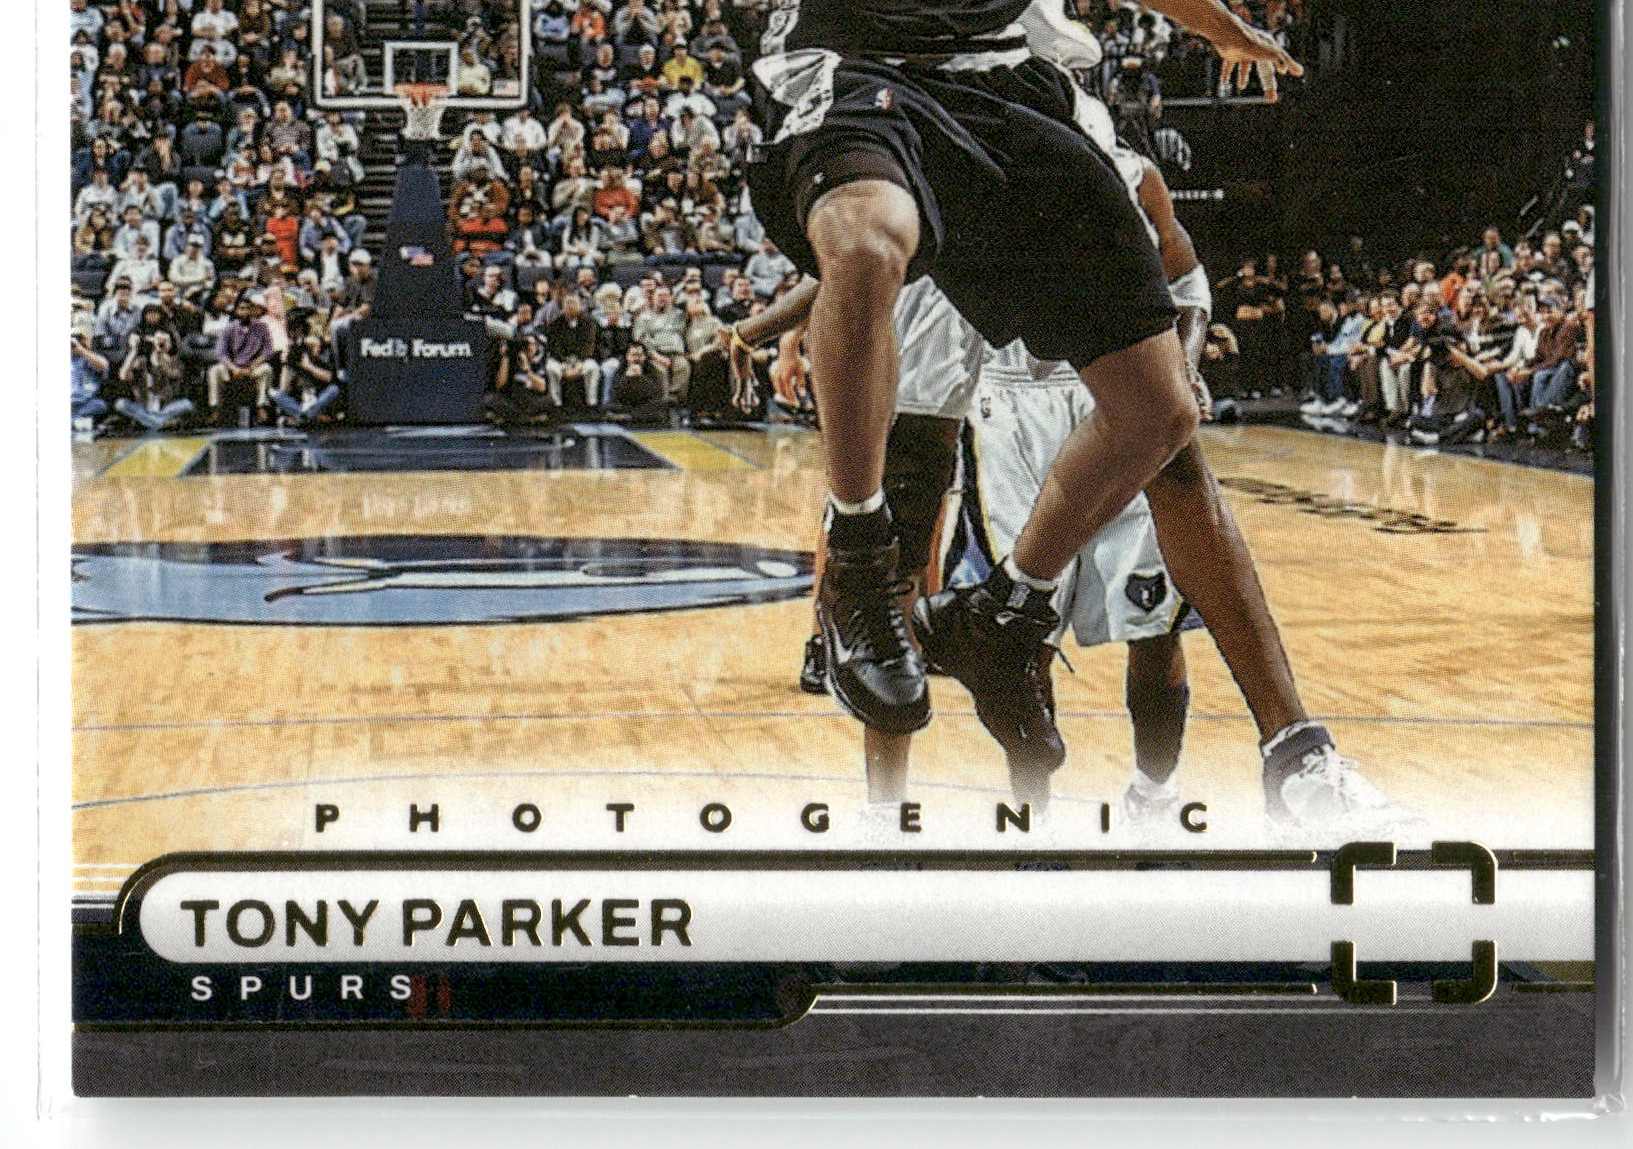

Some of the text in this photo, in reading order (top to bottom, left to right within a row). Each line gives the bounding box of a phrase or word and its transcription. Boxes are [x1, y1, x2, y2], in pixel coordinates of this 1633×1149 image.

[411, 337, 473, 358] Forum
[315, 802, 1208, 834] PHOTOGENIC
[180, 898, 693, 948] TONY PARKER
[190, 973, 412, 1002] SPURS
